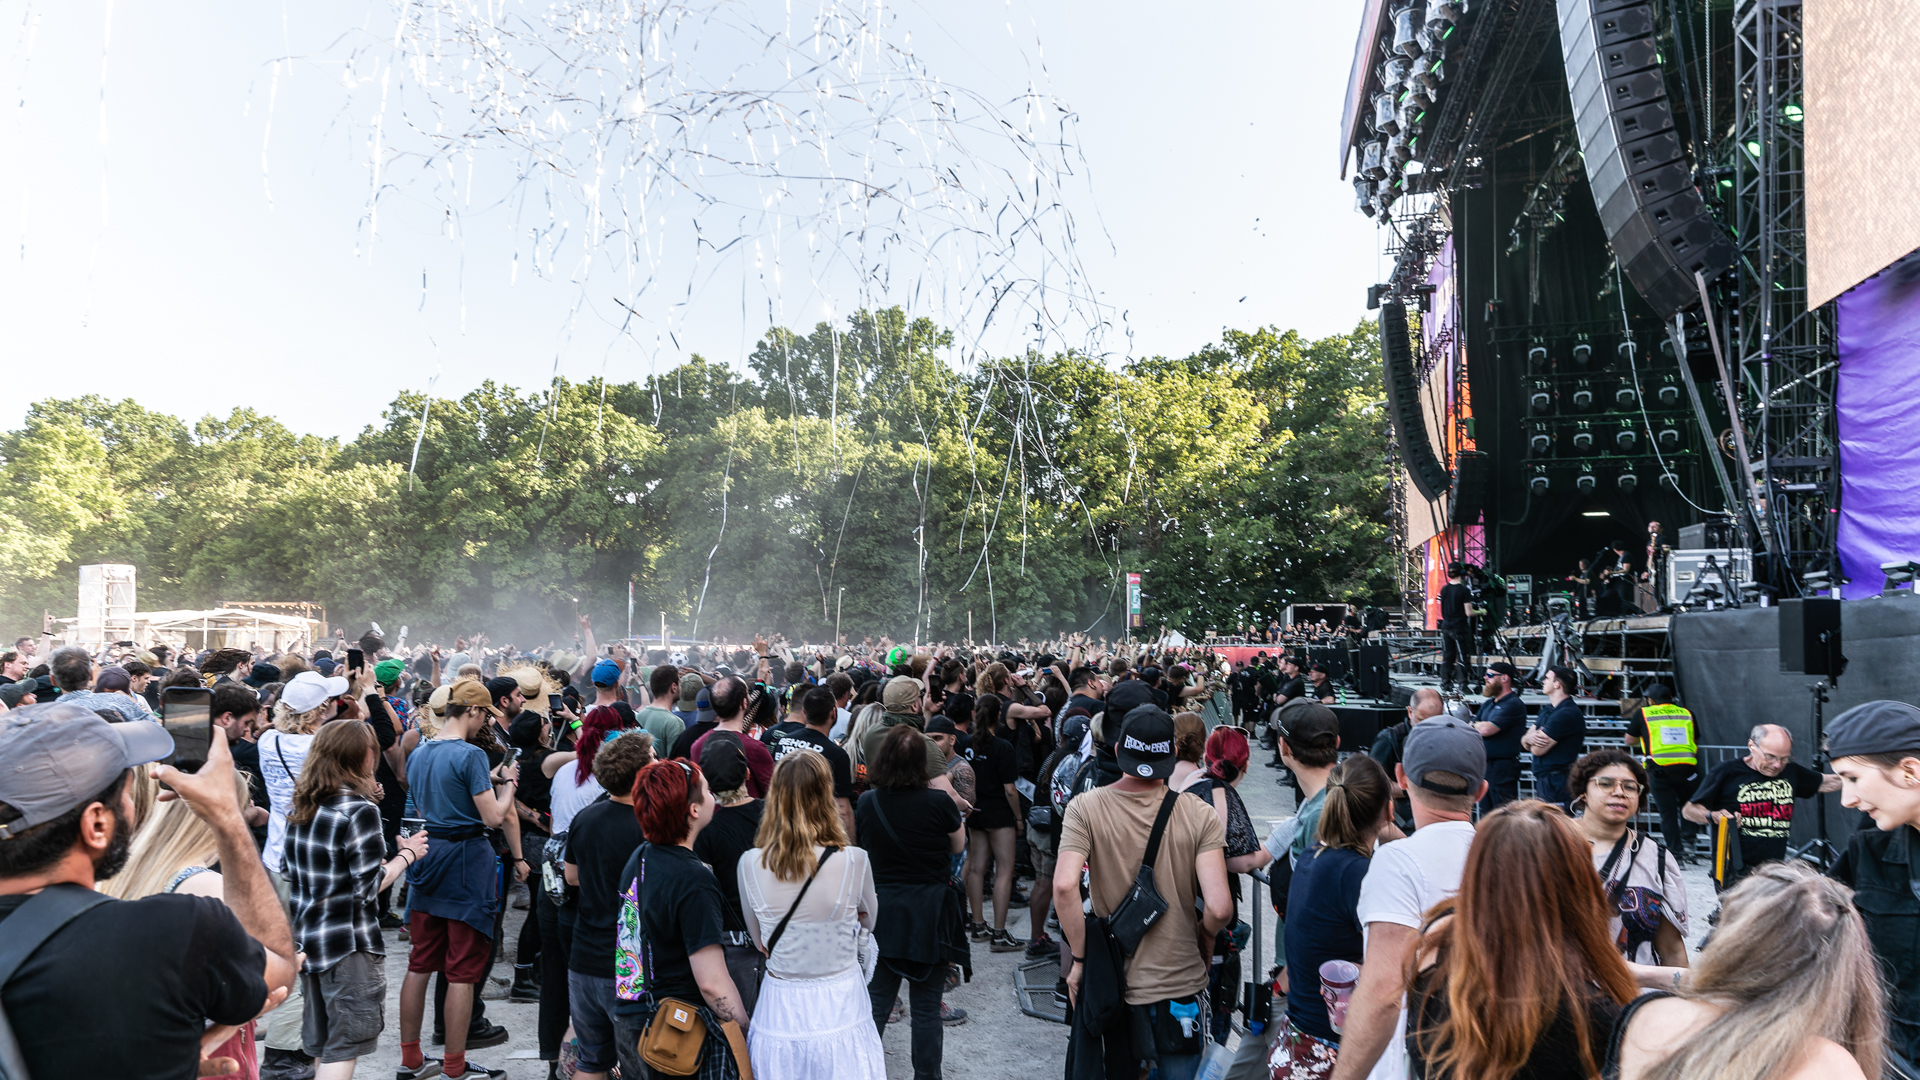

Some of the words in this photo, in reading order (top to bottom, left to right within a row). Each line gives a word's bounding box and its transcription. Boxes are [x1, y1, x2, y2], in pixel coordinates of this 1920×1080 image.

[778, 738, 823, 753] BEHOLD
[782, 745, 798, 754] YO
[1124, 735, 1145, 752] ROCK
[1737, 779, 1793, 804] Greenfield
